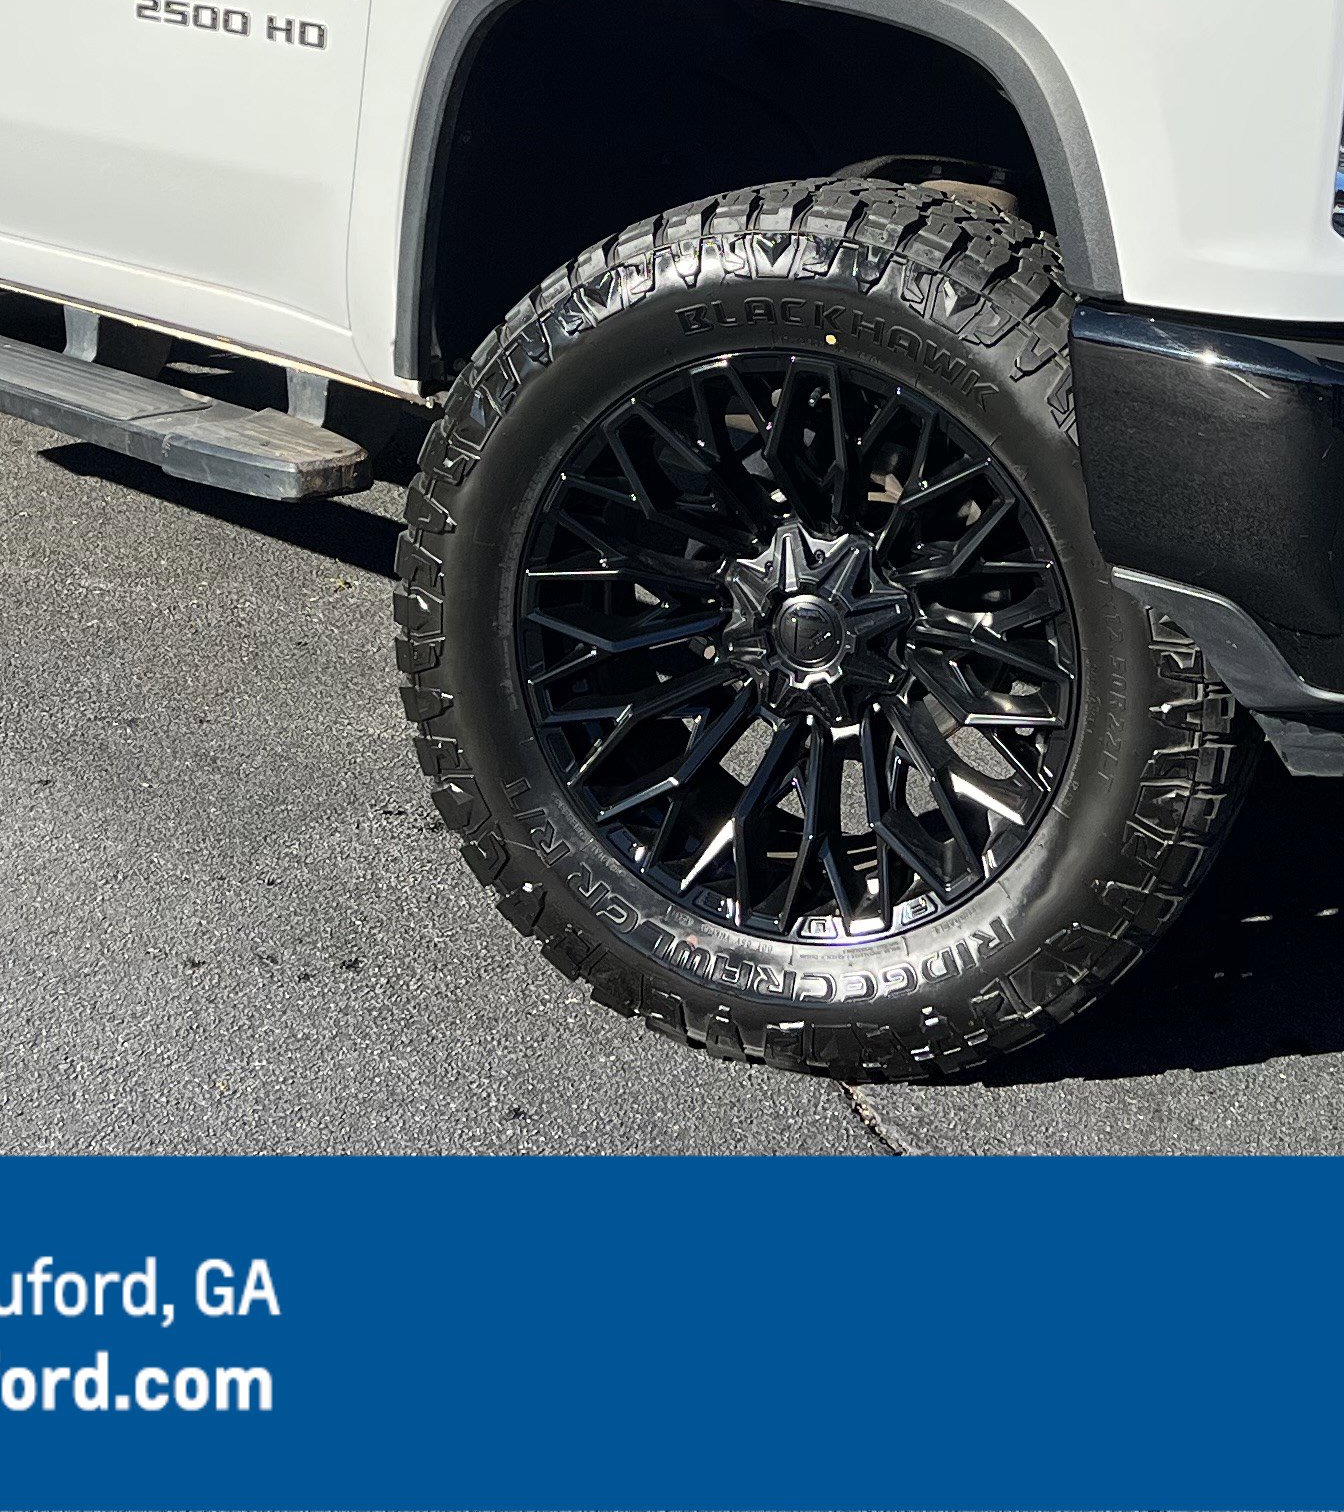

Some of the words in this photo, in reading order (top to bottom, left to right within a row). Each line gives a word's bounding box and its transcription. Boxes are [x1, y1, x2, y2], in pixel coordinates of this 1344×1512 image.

[265, 14, 328, 50] HD
[675, 296, 1000, 412] BLACKHAWK
[567, 861, 1017, 1004] RIDGECRAWLER
